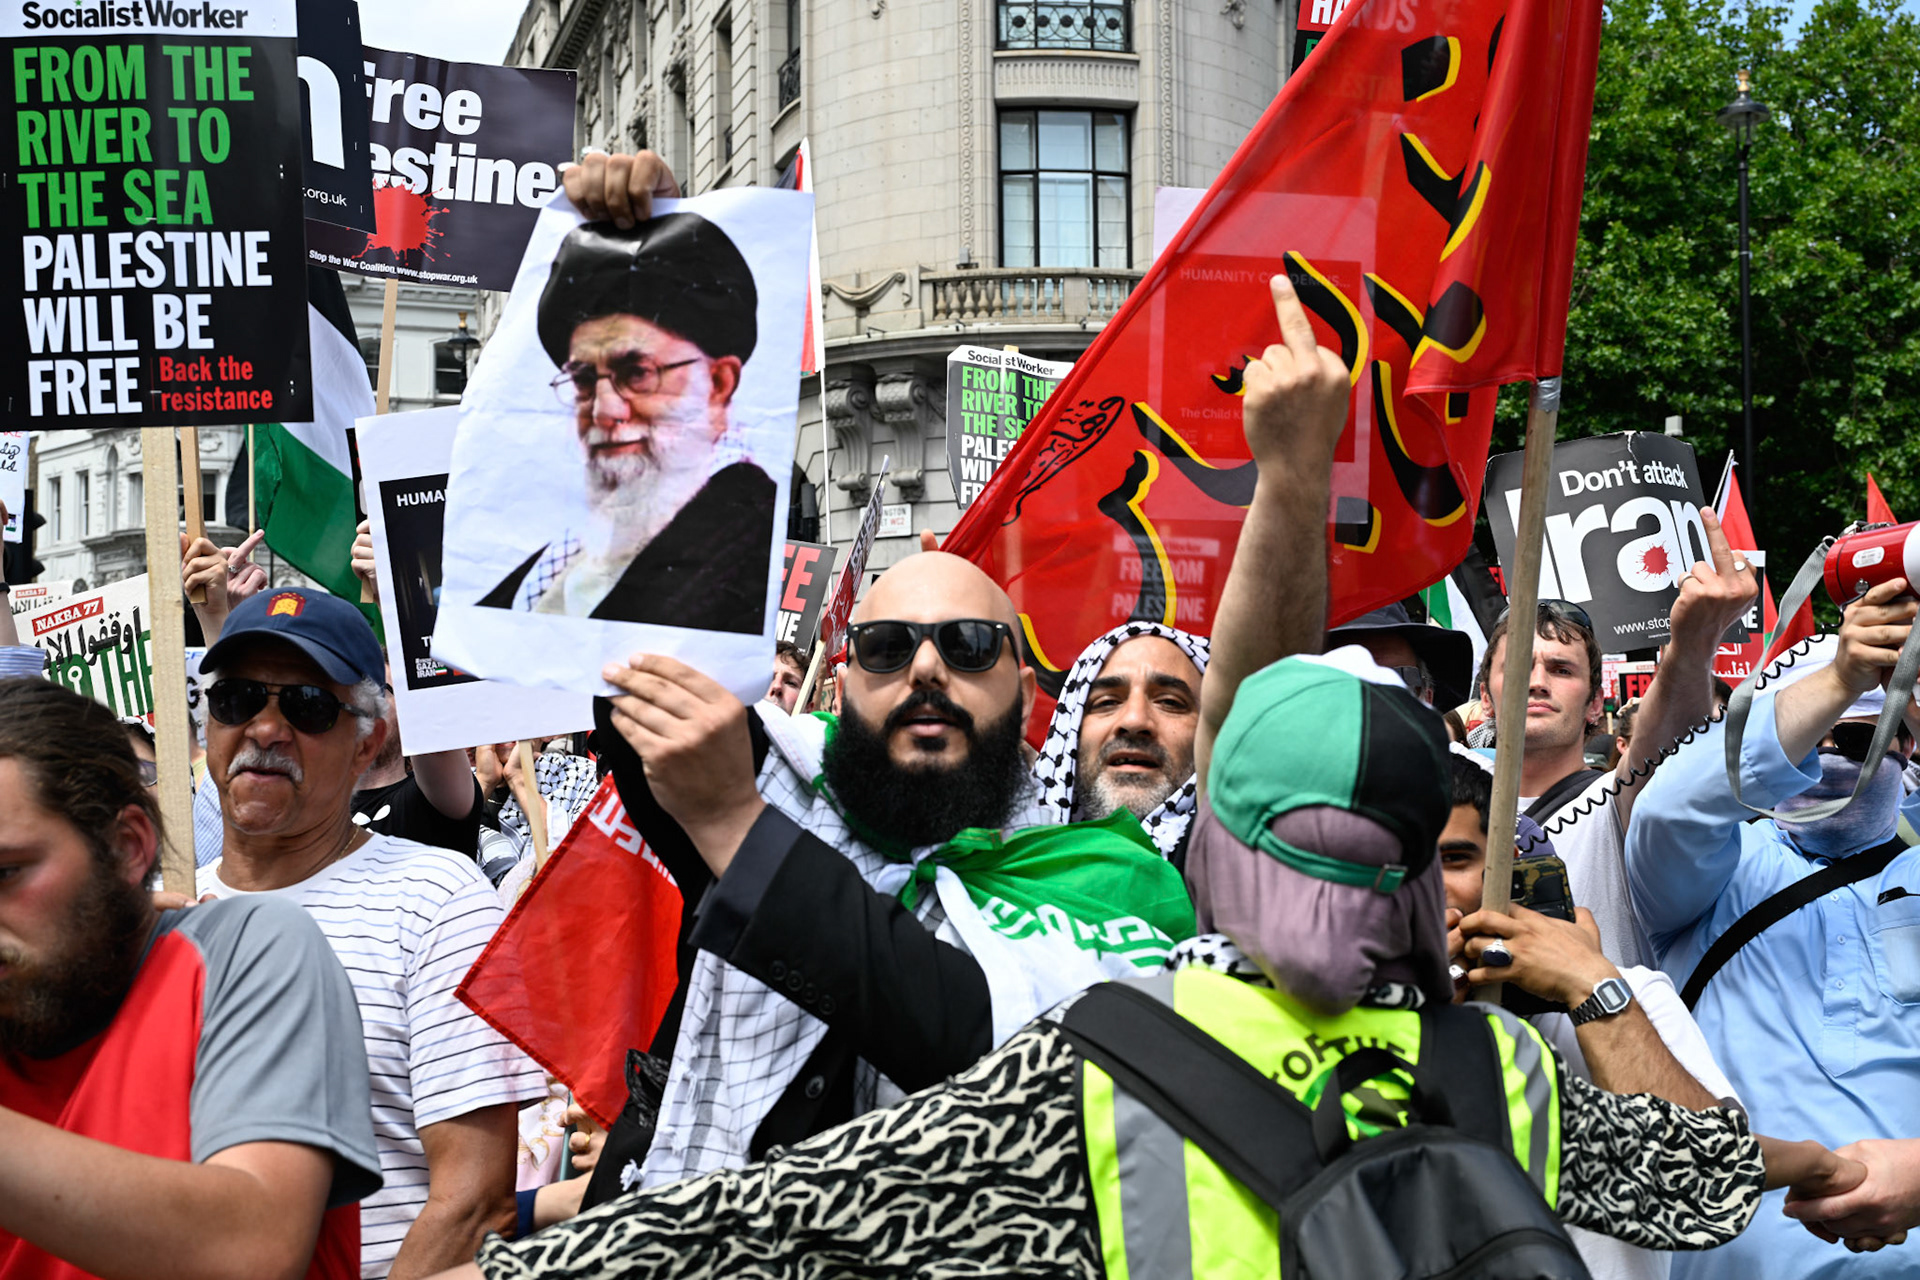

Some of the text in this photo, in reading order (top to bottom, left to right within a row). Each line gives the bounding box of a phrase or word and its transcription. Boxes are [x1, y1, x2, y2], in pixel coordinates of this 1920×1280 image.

[22, 0, 248, 28] Socialist Worker
[13, 45, 254, 103] FROM THE
[17, 107, 153, 166] RIVER
[168, 107, 231, 164] TO
[17, 169, 214, 228] THE SEA
[22, 231, 273, 291] PALESTINE
[309, 249, 478, 284] Stop the War Coalition www.stopwar.org.uk
[1180, 268, 1255, 283] HUMANITY
[22, 294, 214, 354] WILL BE
[159, 355, 253, 382] Back the
[1016, 357, 1055, 376] Worker
[28, 357, 143, 417] FREE
[161, 386, 273, 412] resistance
[962, 366, 1057, 401] FROM THE
[962, 389, 1017, 416] RIVER
[961, 412, 1031, 440] THE SE
[1559, 460, 1688, 497] Don't attack
[1504, 488, 1716, 604] Iran
[1120, 557, 1205, 584] FREEDOM
[35, 608, 83, 632] NAKBA
[83, 600, 100, 615] 77
[1111, 593, 1205, 622] PALESTINE
[1613, 617, 1671, 635] www.stop
